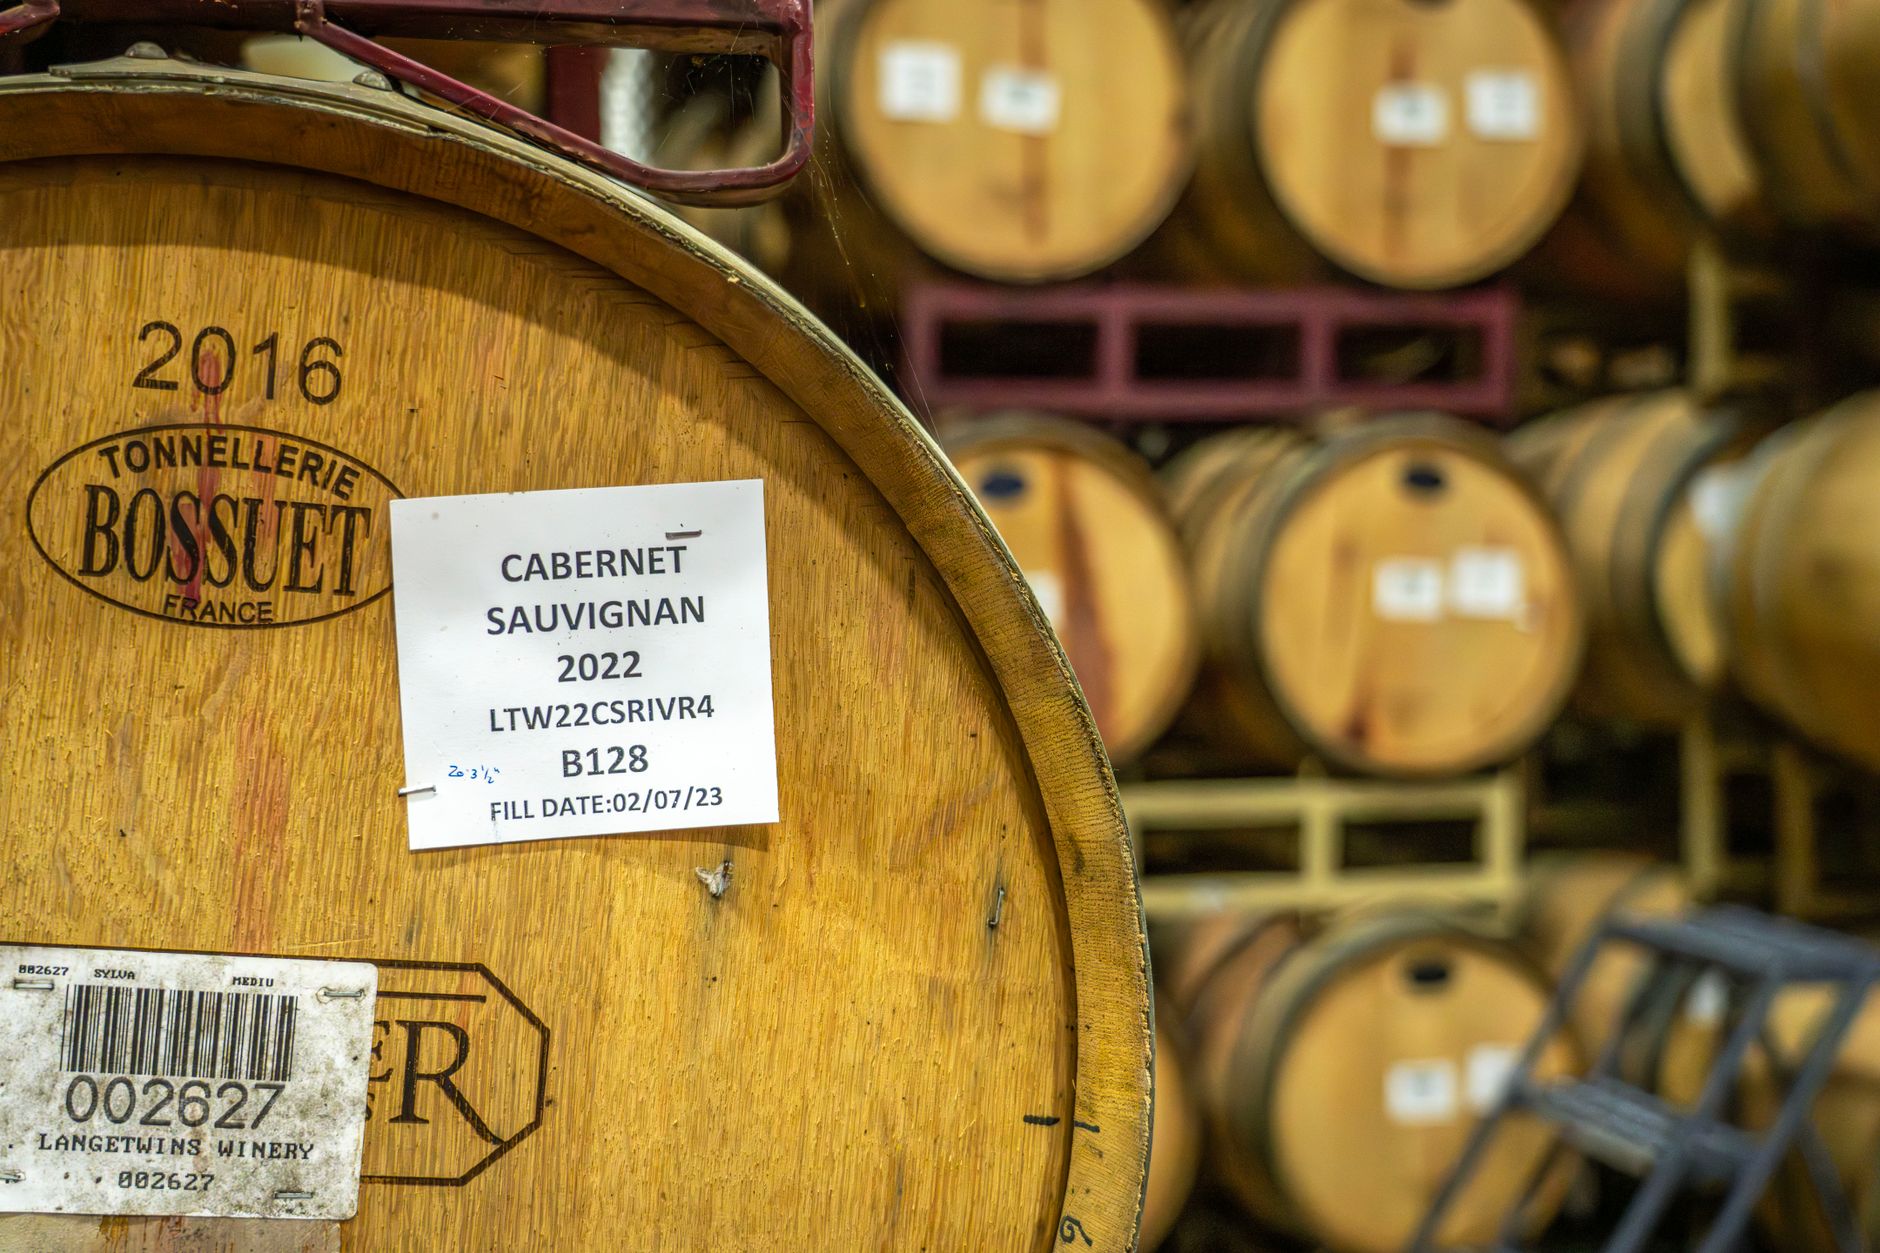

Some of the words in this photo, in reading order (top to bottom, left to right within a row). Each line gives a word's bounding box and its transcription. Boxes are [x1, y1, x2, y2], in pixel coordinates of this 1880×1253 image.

[132, 320, 343, 406] 2016
[98, 434, 361, 500] TONNELLERIE
[78, 483, 372, 597] BOSSUET
[501, 545, 688, 583] CABERNET
[163, 593, 274, 625] FRANCE
[486, 596, 706, 636] SAUVIGNAN
[557, 650, 643, 683] 2022
[489, 694, 715, 733] LTW22CSRIVR4
[561, 744, 649, 778] B128
[490, 799, 535, 821] FILL
[542, 786, 724, 818] DATE:02/07/23
[18, 964, 69, 976] 002627
[94, 968, 136, 980] SYLVA
[232, 976, 274, 987] MEDIU
[65, 1074, 286, 1130] 002627
[38, 1133, 202, 1156] LANGETWINS
[217, 1139, 315, 1160] WINERY
[118, 1170, 215, 1192] 002627
